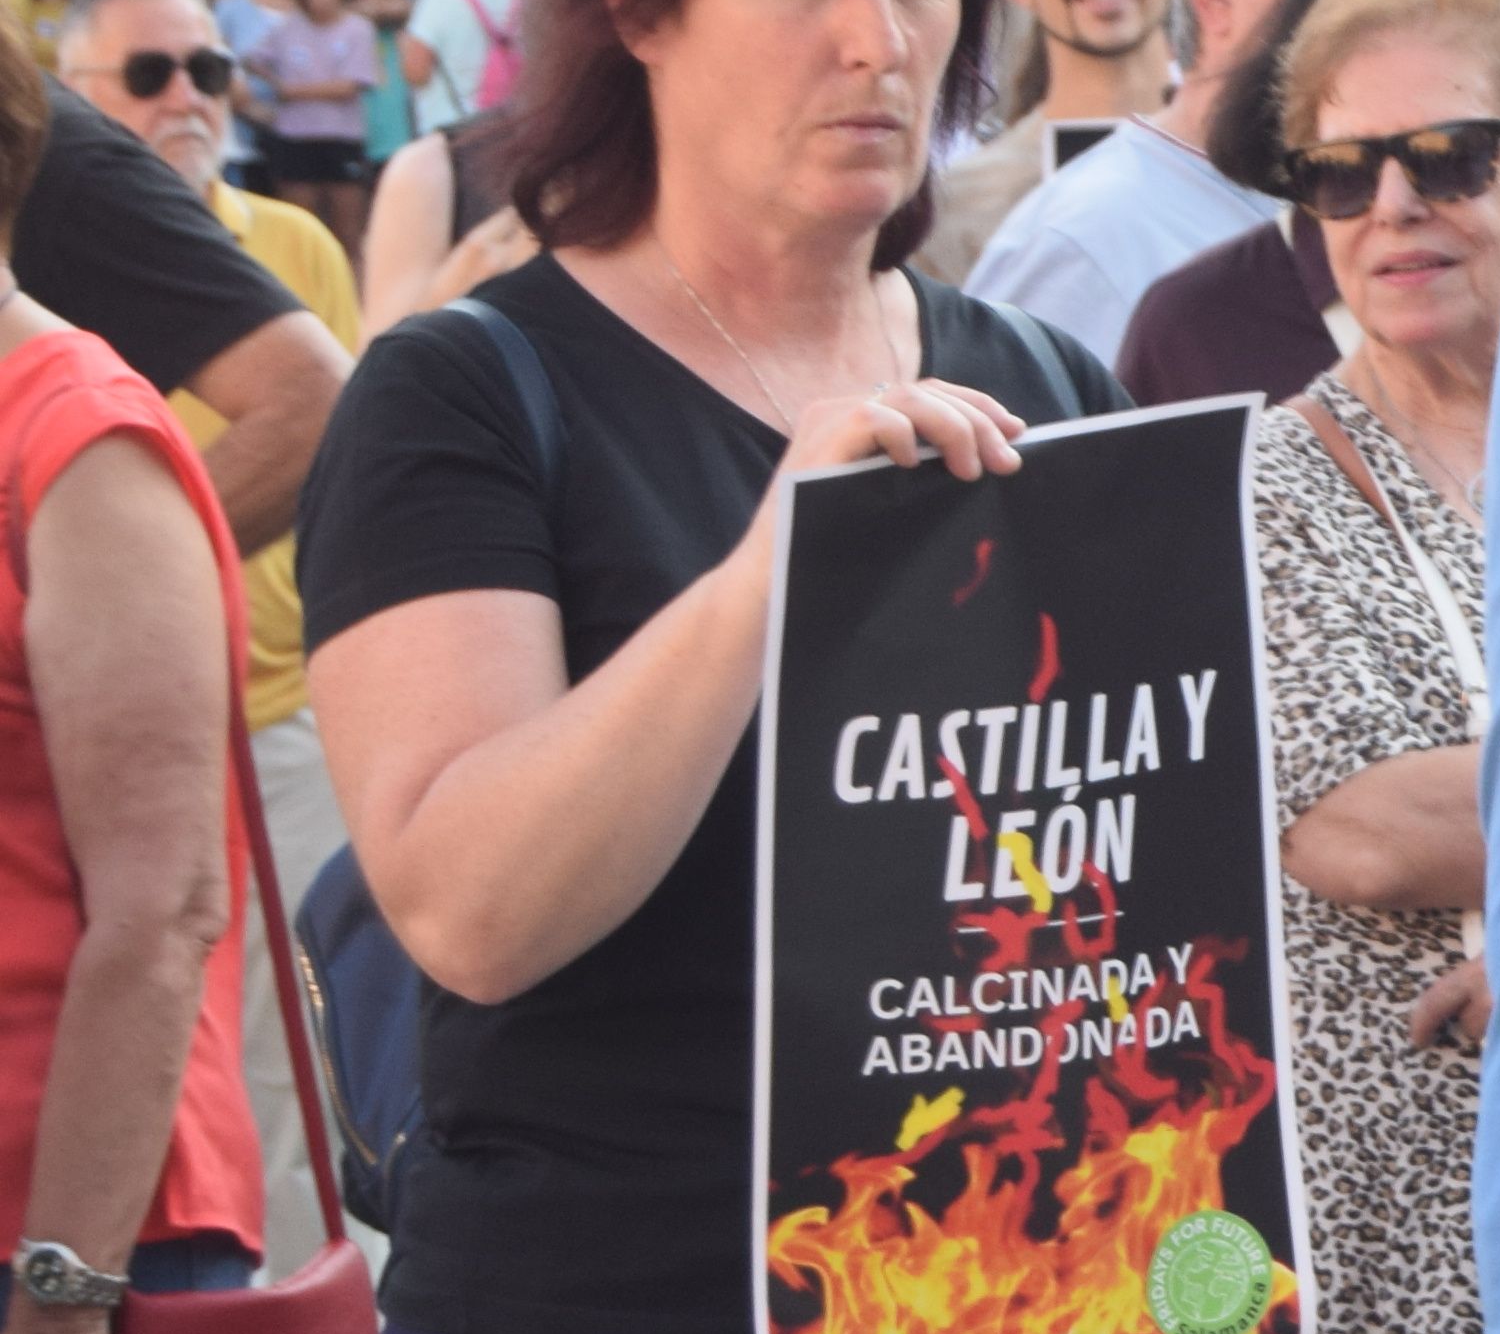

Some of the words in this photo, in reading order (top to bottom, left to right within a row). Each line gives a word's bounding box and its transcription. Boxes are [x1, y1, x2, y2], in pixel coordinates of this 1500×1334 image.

[833, 681, 1161, 804] CASTILLA
[1178, 668, 1218, 761] Y
[943, 784, 1137, 902] LEÓN
[860, 1000, 1202, 1077] ABANDONADA
[868, 952, 1157, 1021] CALCINADA
[1165, 941, 1194, 985] Y
[1150, 1247, 1180, 1331] FRIDAYS
[1169, 1217, 1208, 1247] FOR
[1211, 1216, 1268, 1276] FUTURE
